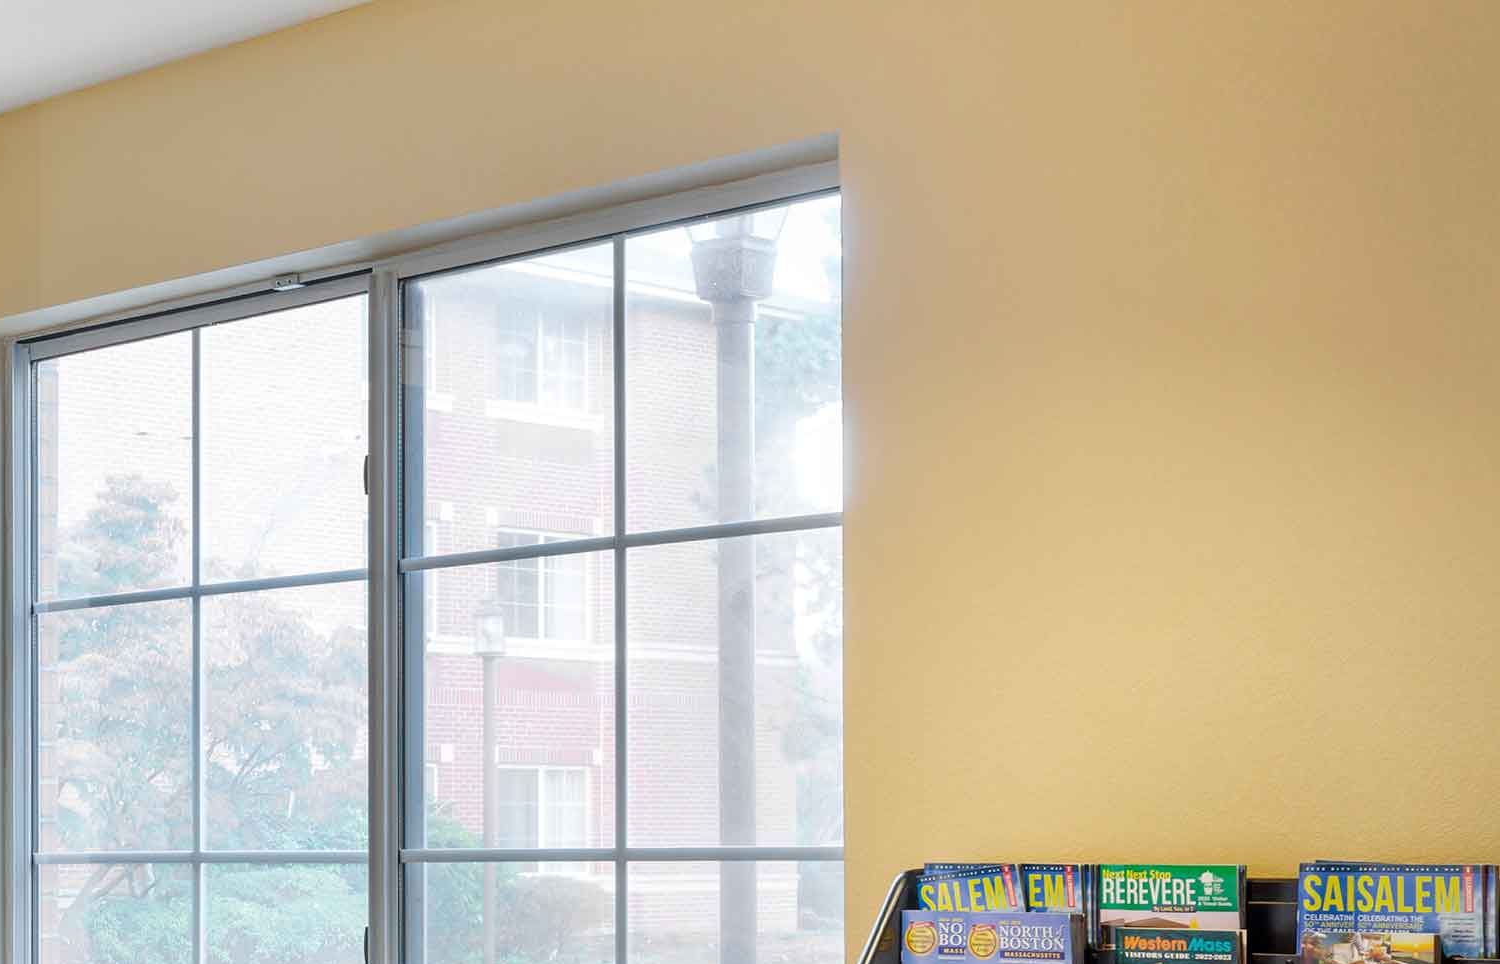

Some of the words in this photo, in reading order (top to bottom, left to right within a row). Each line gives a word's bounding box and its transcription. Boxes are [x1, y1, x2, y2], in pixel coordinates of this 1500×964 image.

[1150, 871, 1171, 880] Stop
[921, 876, 1007, 912] SALEM
[1000, 926, 1052, 937] NORTH
[1000, 938, 1064, 950] BOSTON
[1124, 936, 1187, 951] Western
[1188, 937, 1231, 952] Mass
